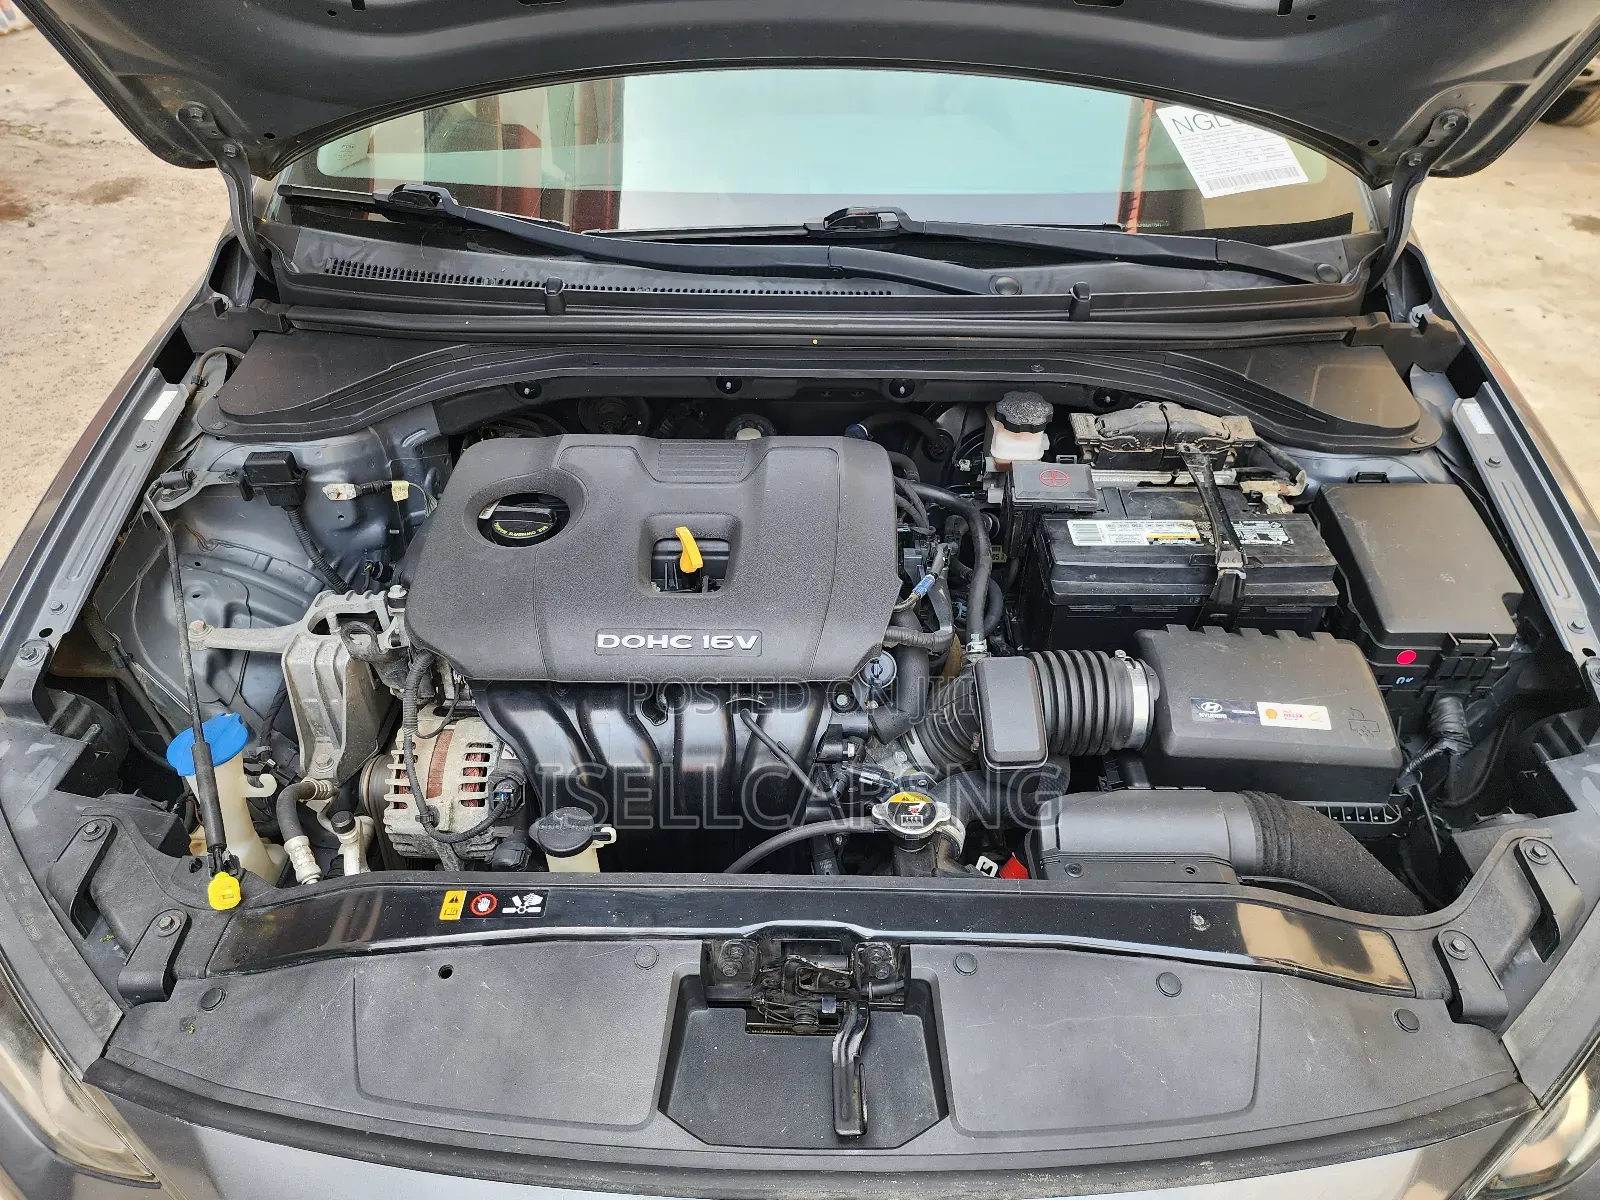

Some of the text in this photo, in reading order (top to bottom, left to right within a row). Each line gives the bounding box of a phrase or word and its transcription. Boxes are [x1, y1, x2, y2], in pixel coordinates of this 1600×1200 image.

[1172, 113, 1241, 135] NGL
[597, 634, 759, 651] DOHC 16V
